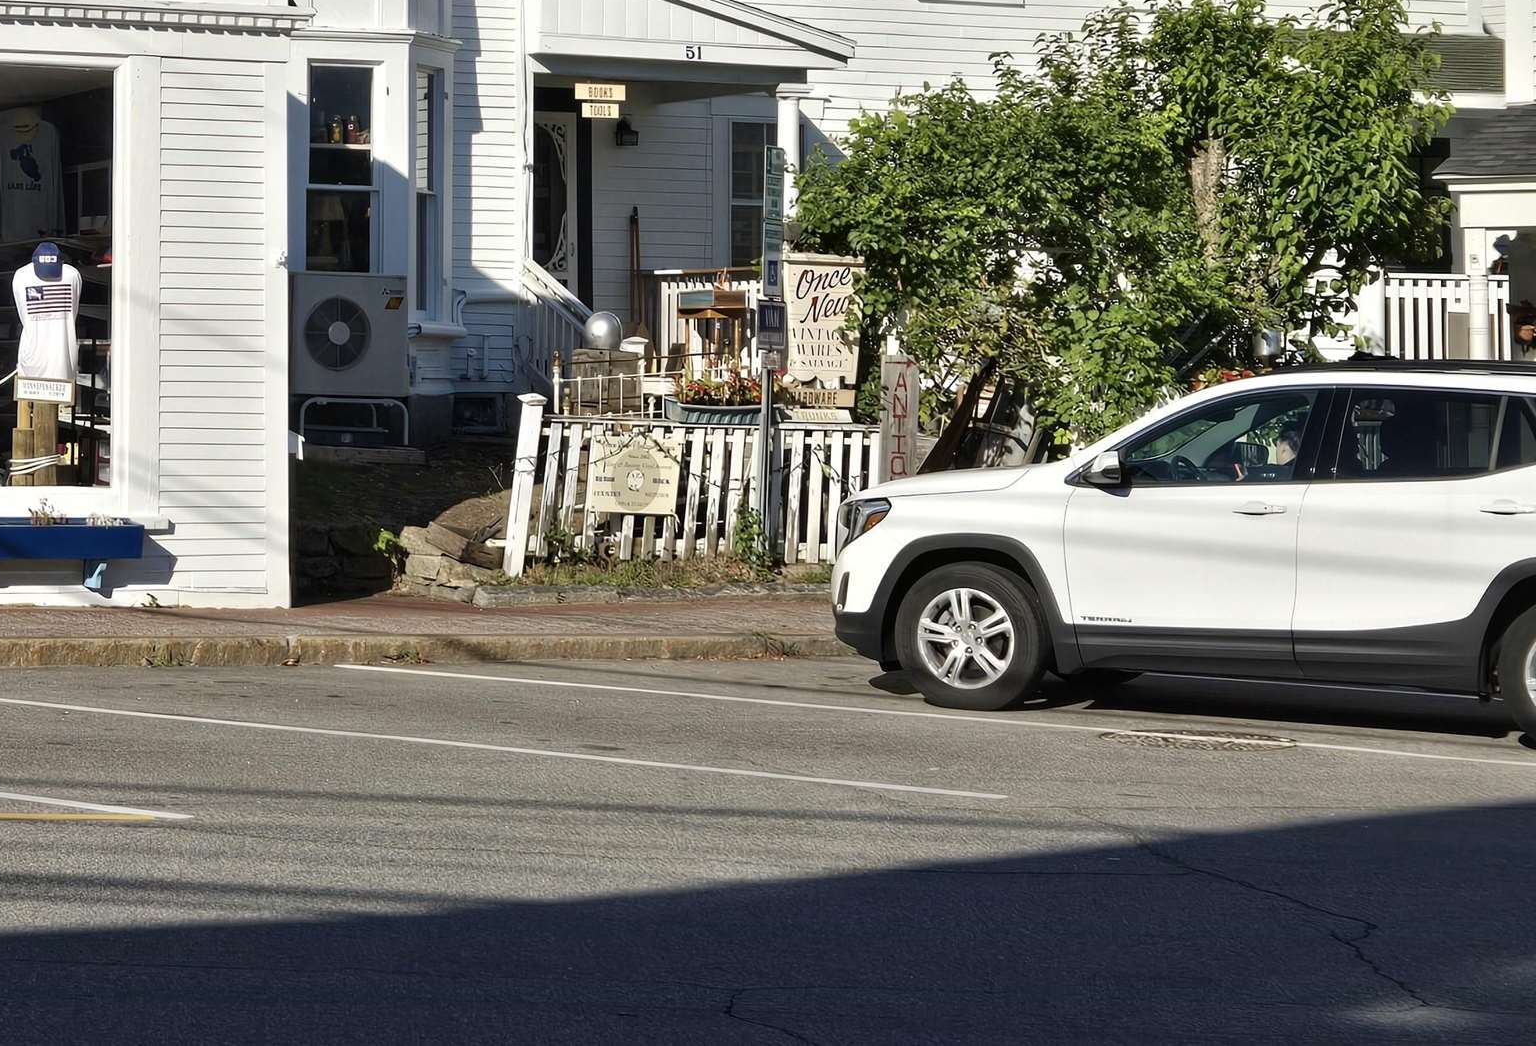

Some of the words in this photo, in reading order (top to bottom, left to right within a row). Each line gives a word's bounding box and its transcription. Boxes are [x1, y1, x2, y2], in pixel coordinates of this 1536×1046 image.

[685, 45, 703, 60] 51
[588, 86, 613, 98] BOOKS
[589, 104, 612, 117] TOOLS
[796, 266, 852, 300] Once
[800, 293, 851, 324] New
[792, 327, 844, 341] VINTAG
[890, 372, 908, 481] ANTIQ
